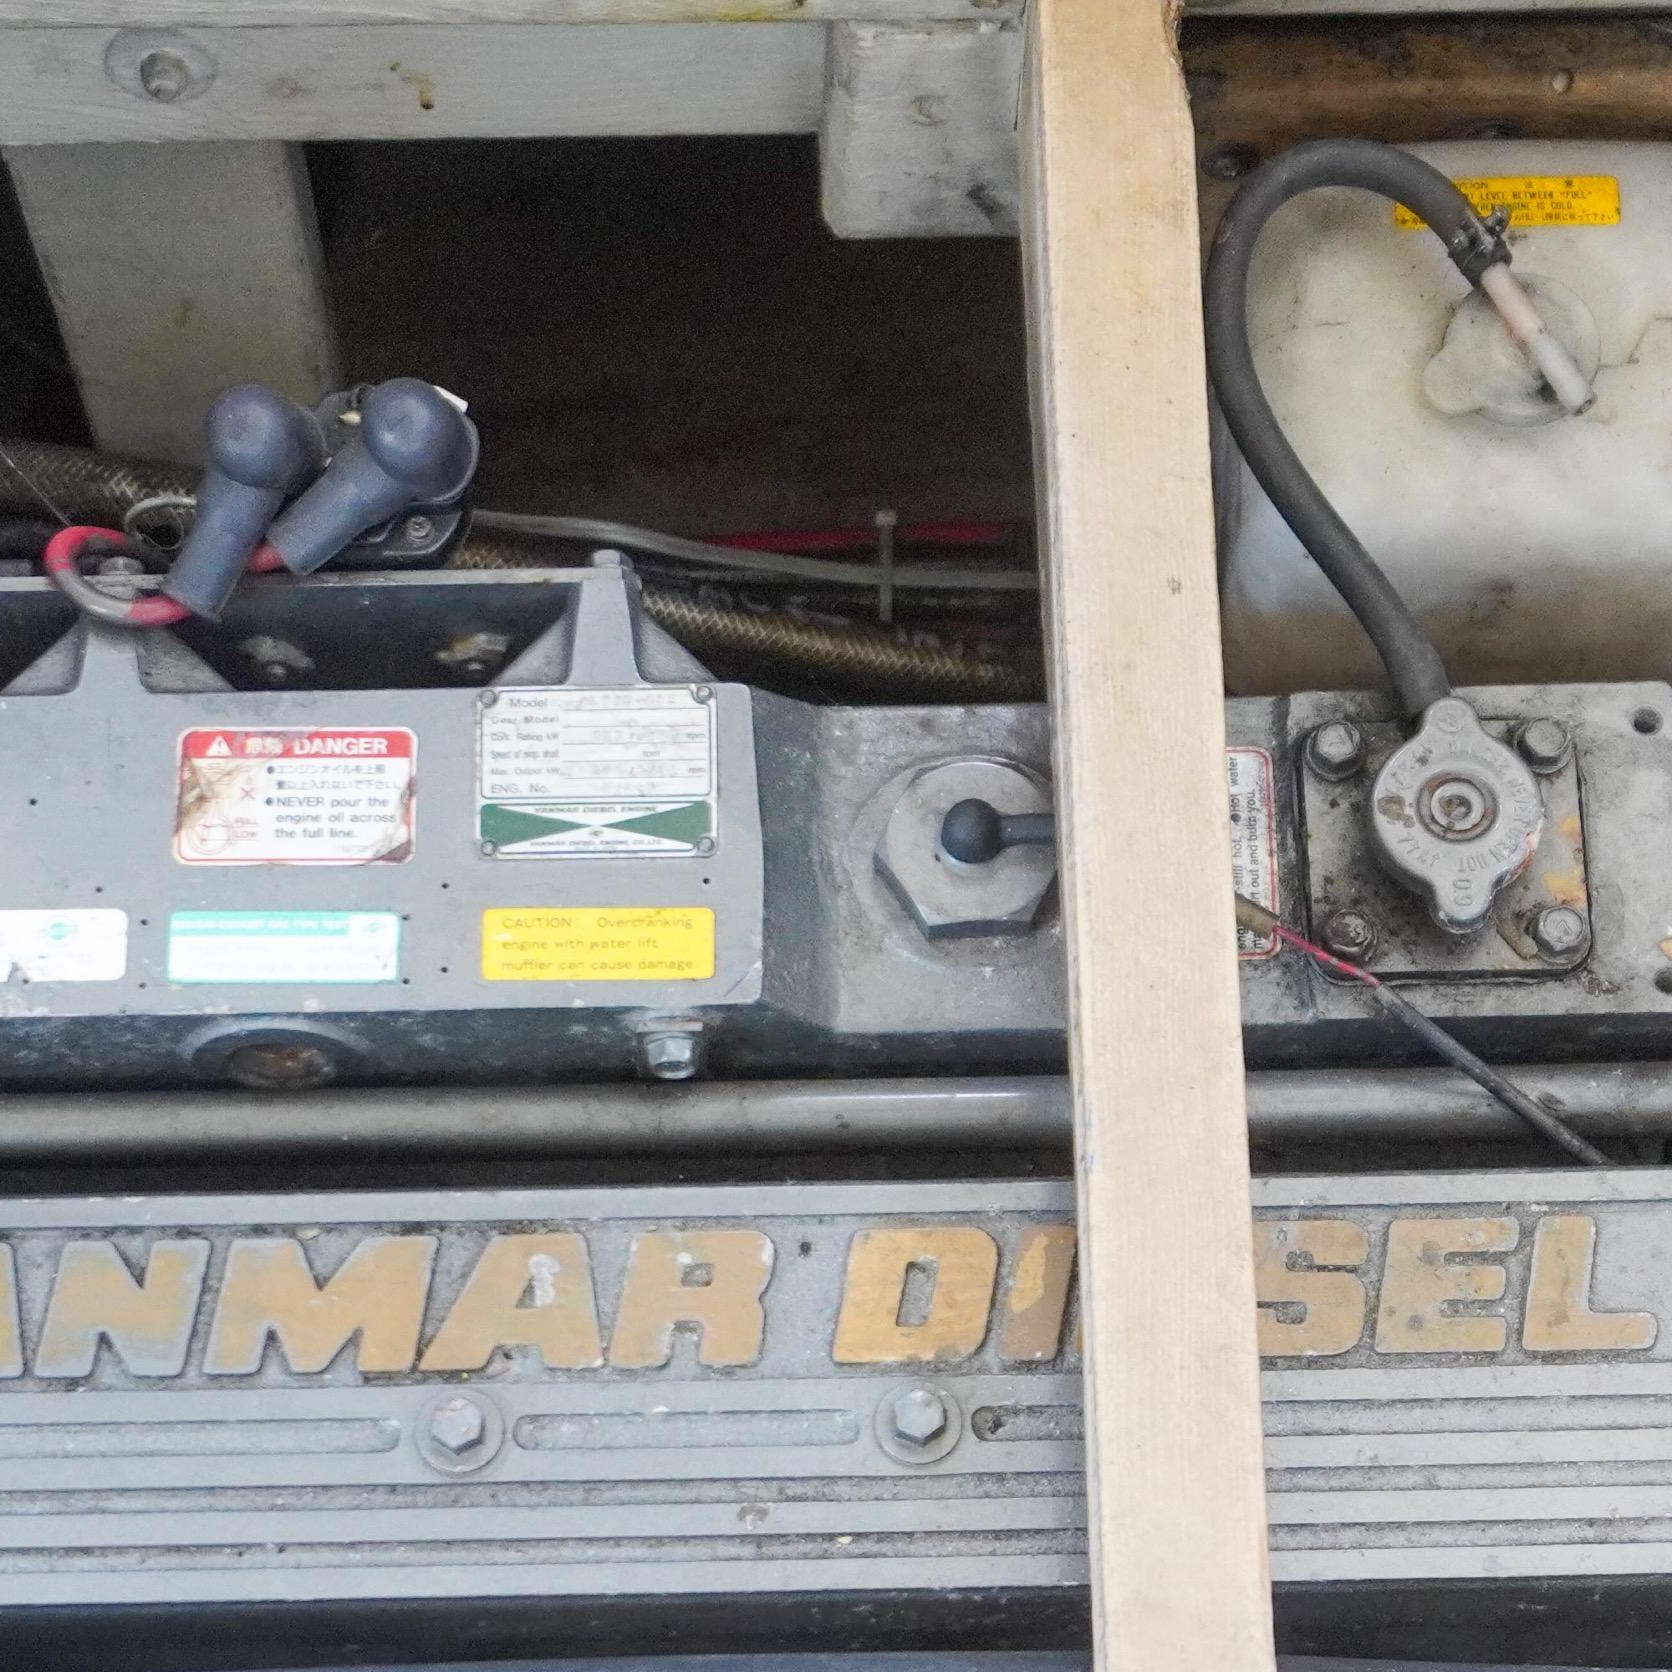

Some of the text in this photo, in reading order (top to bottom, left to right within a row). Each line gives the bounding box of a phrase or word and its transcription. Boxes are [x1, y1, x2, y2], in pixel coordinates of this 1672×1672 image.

[508, 698, 547, 708] Model
[293, 737, 389, 755] DANGER
[1229, 757, 1238, 786] water
[276, 797, 389, 810] NEVER pour the
[275, 812, 396, 825] engine oil across
[275, 828, 296, 838] the
[302, 828, 323, 838] full
[1249, 843, 1258, 866] and
[1251, 874, 1261, 889] out
[501, 916, 694, 930] CAUTION Overcranking
[501, 940, 548, 951] engine
[555, 938, 585, 949] with
[638, 938, 659, 949] lift
[501, 959, 553, 971] muffler
[559, 961, 585, 970] can
[591, 961, 633, 970] cause
[831, 1215, 1659, 1364] DISEL
